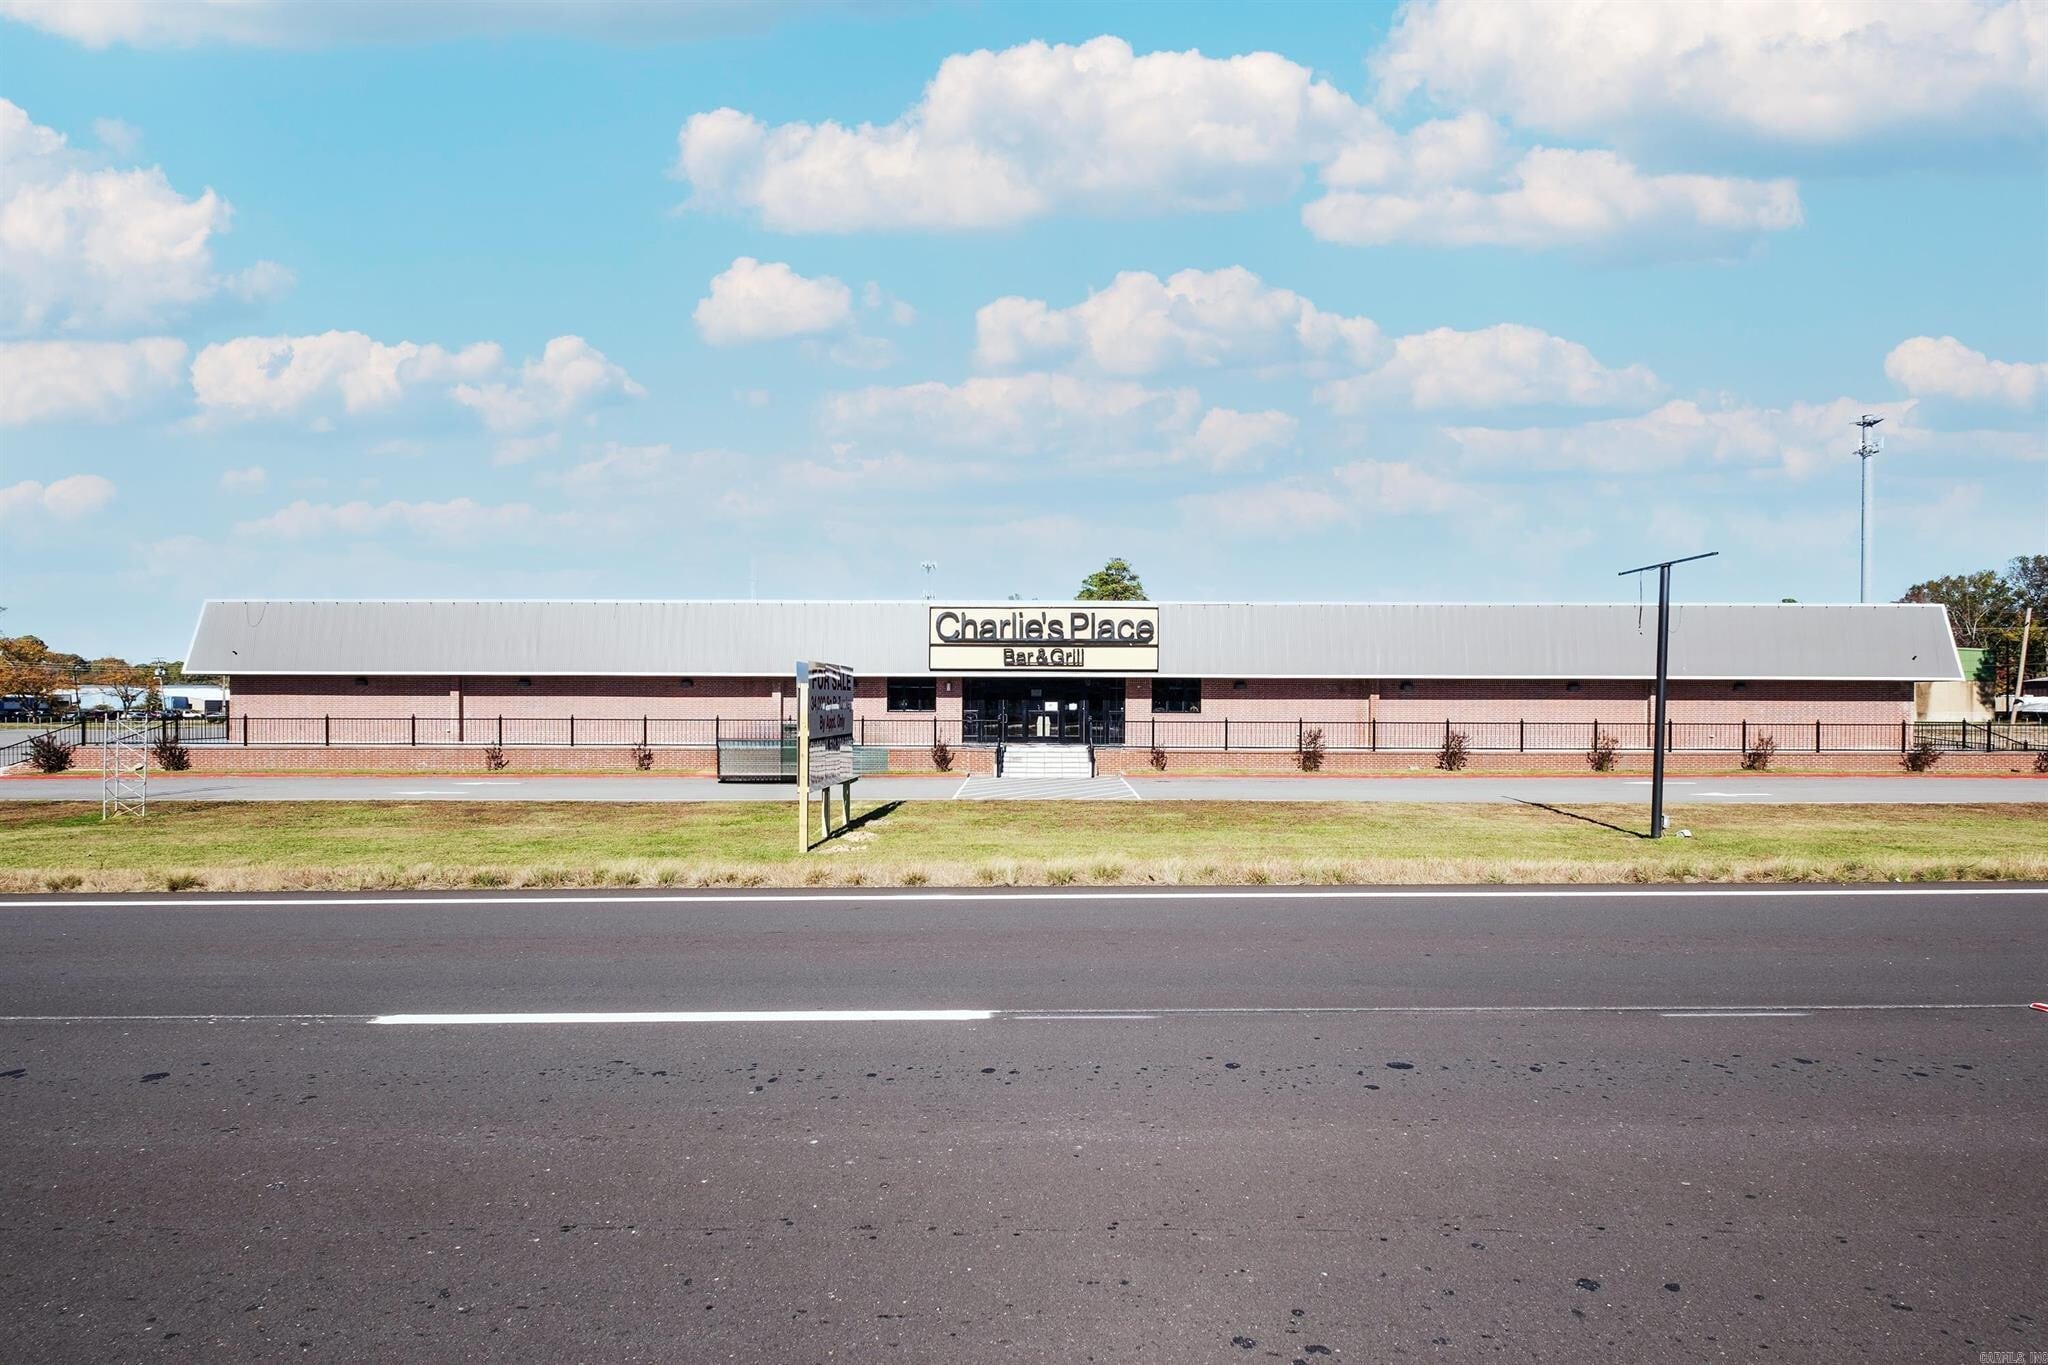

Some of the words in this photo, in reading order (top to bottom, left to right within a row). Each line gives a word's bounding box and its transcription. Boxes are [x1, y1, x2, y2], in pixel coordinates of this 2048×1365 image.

[936, 611, 1064, 642] Charlie's
[1070, 612, 1154, 642] Place
[1003, 648, 1034, 666] Bar
[1050, 648, 1084, 666] Grill
[812, 669, 830, 690] FOR
[832, 670, 852, 691] SALE
